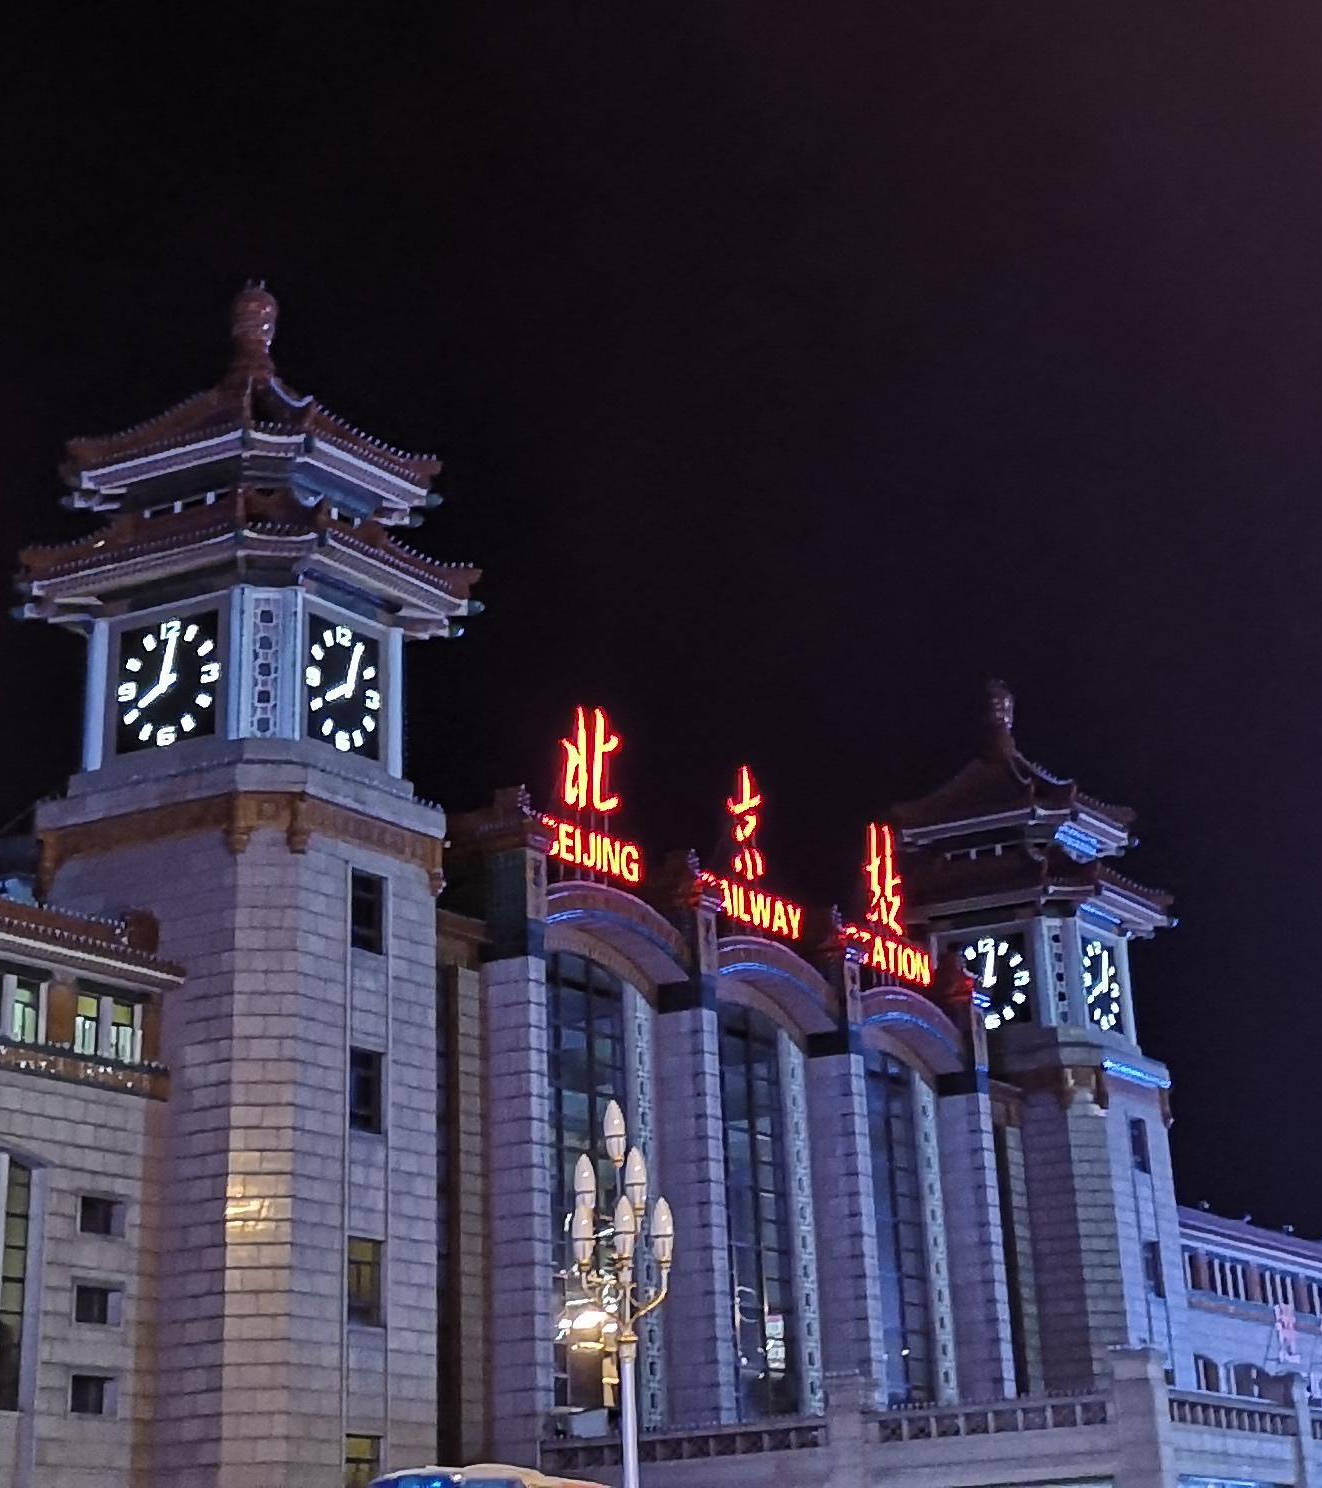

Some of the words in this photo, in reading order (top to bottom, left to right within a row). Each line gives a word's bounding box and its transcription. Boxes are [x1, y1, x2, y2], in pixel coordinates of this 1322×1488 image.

[200, 662, 220, 683] 3
[117, 682, 137, 702] 9
[365, 689, 380, 710] 3
[156, 725, 176, 747] 6
[845, 925, 932, 987] ATION
